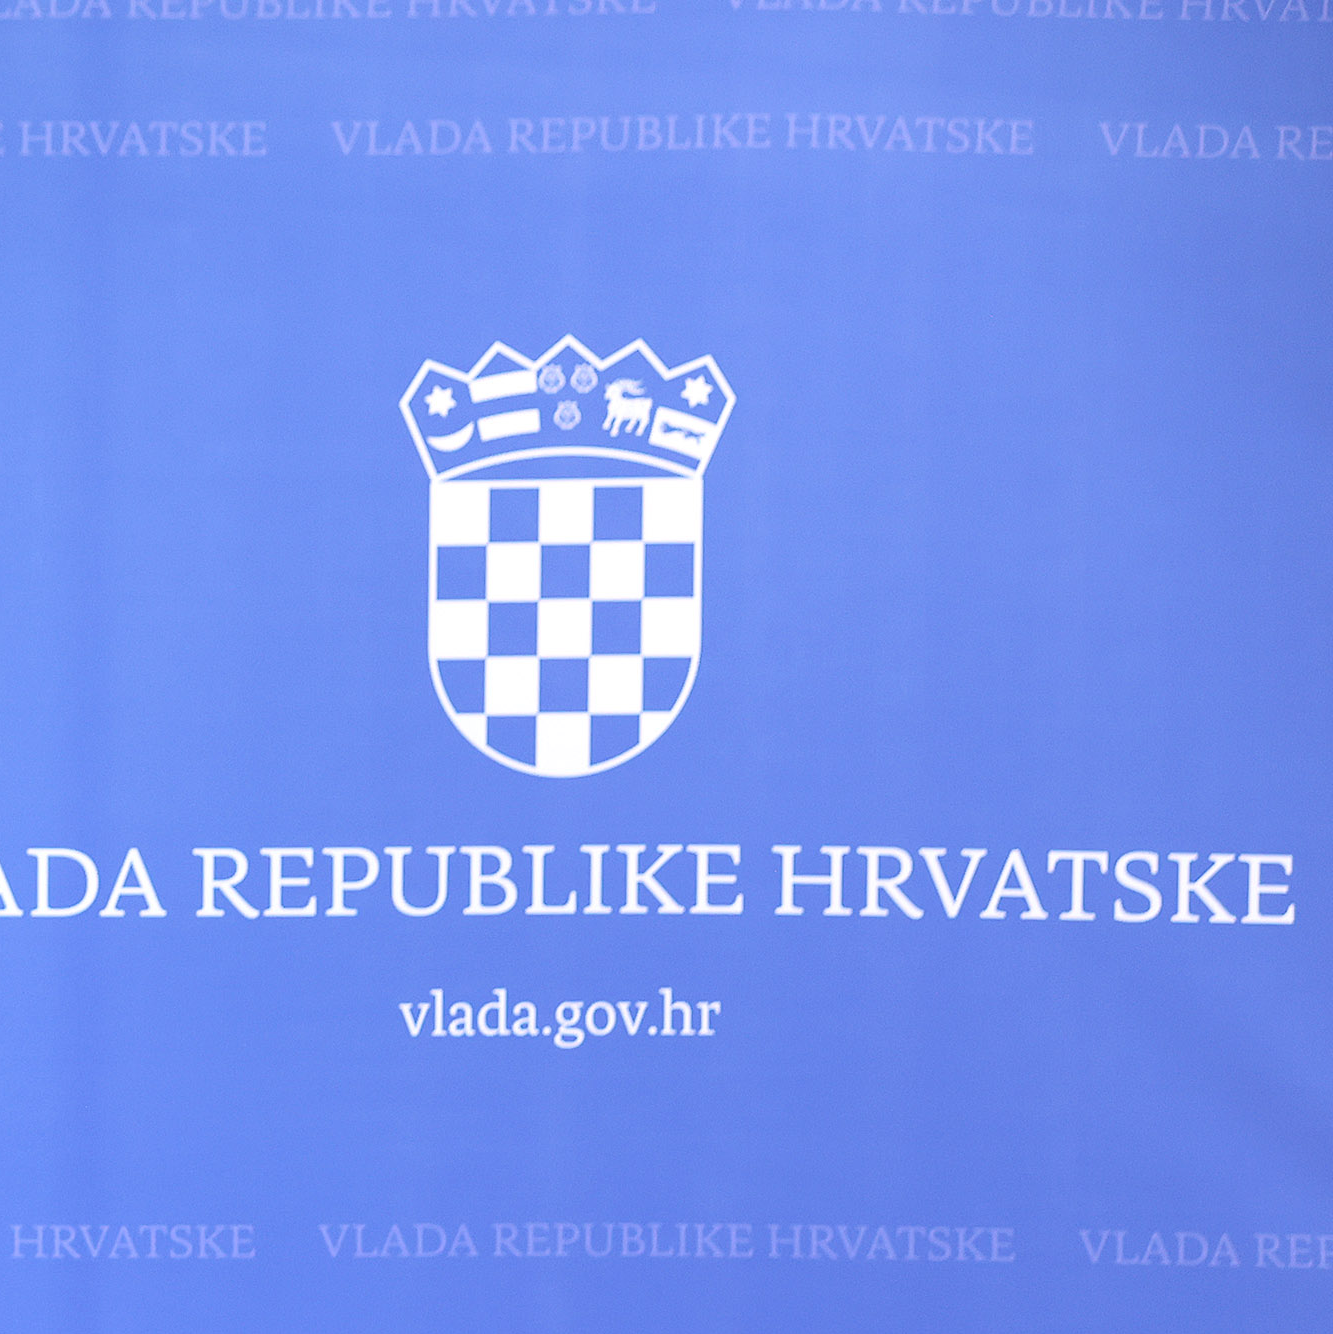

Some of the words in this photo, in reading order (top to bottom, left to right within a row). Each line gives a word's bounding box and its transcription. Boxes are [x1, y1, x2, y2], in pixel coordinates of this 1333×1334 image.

[17, 120, 269, 157] HRVATSKE
[329, 118, 494, 156] VLADA
[507, 114, 772, 154] REPUBLIKE
[784, 114, 1035, 155] HRVATSKE
[1098, 121, 1262, 159] VLADA
[192, 844, 744, 919] REPUBLIKE
[772, 845, 1295, 925] HRVATSKE
[399, 987, 721, 1050] vlada.gov.hr
[9, 1224, 257, 1260] HRVATSKE
[317, 1222, 480, 1259] VLADA
[491, 1222, 755, 1259] REPUBLIKE
[767, 1224, 1016, 1263] HRVATSKE
[1078, 1229, 1242, 1268] VLADA
